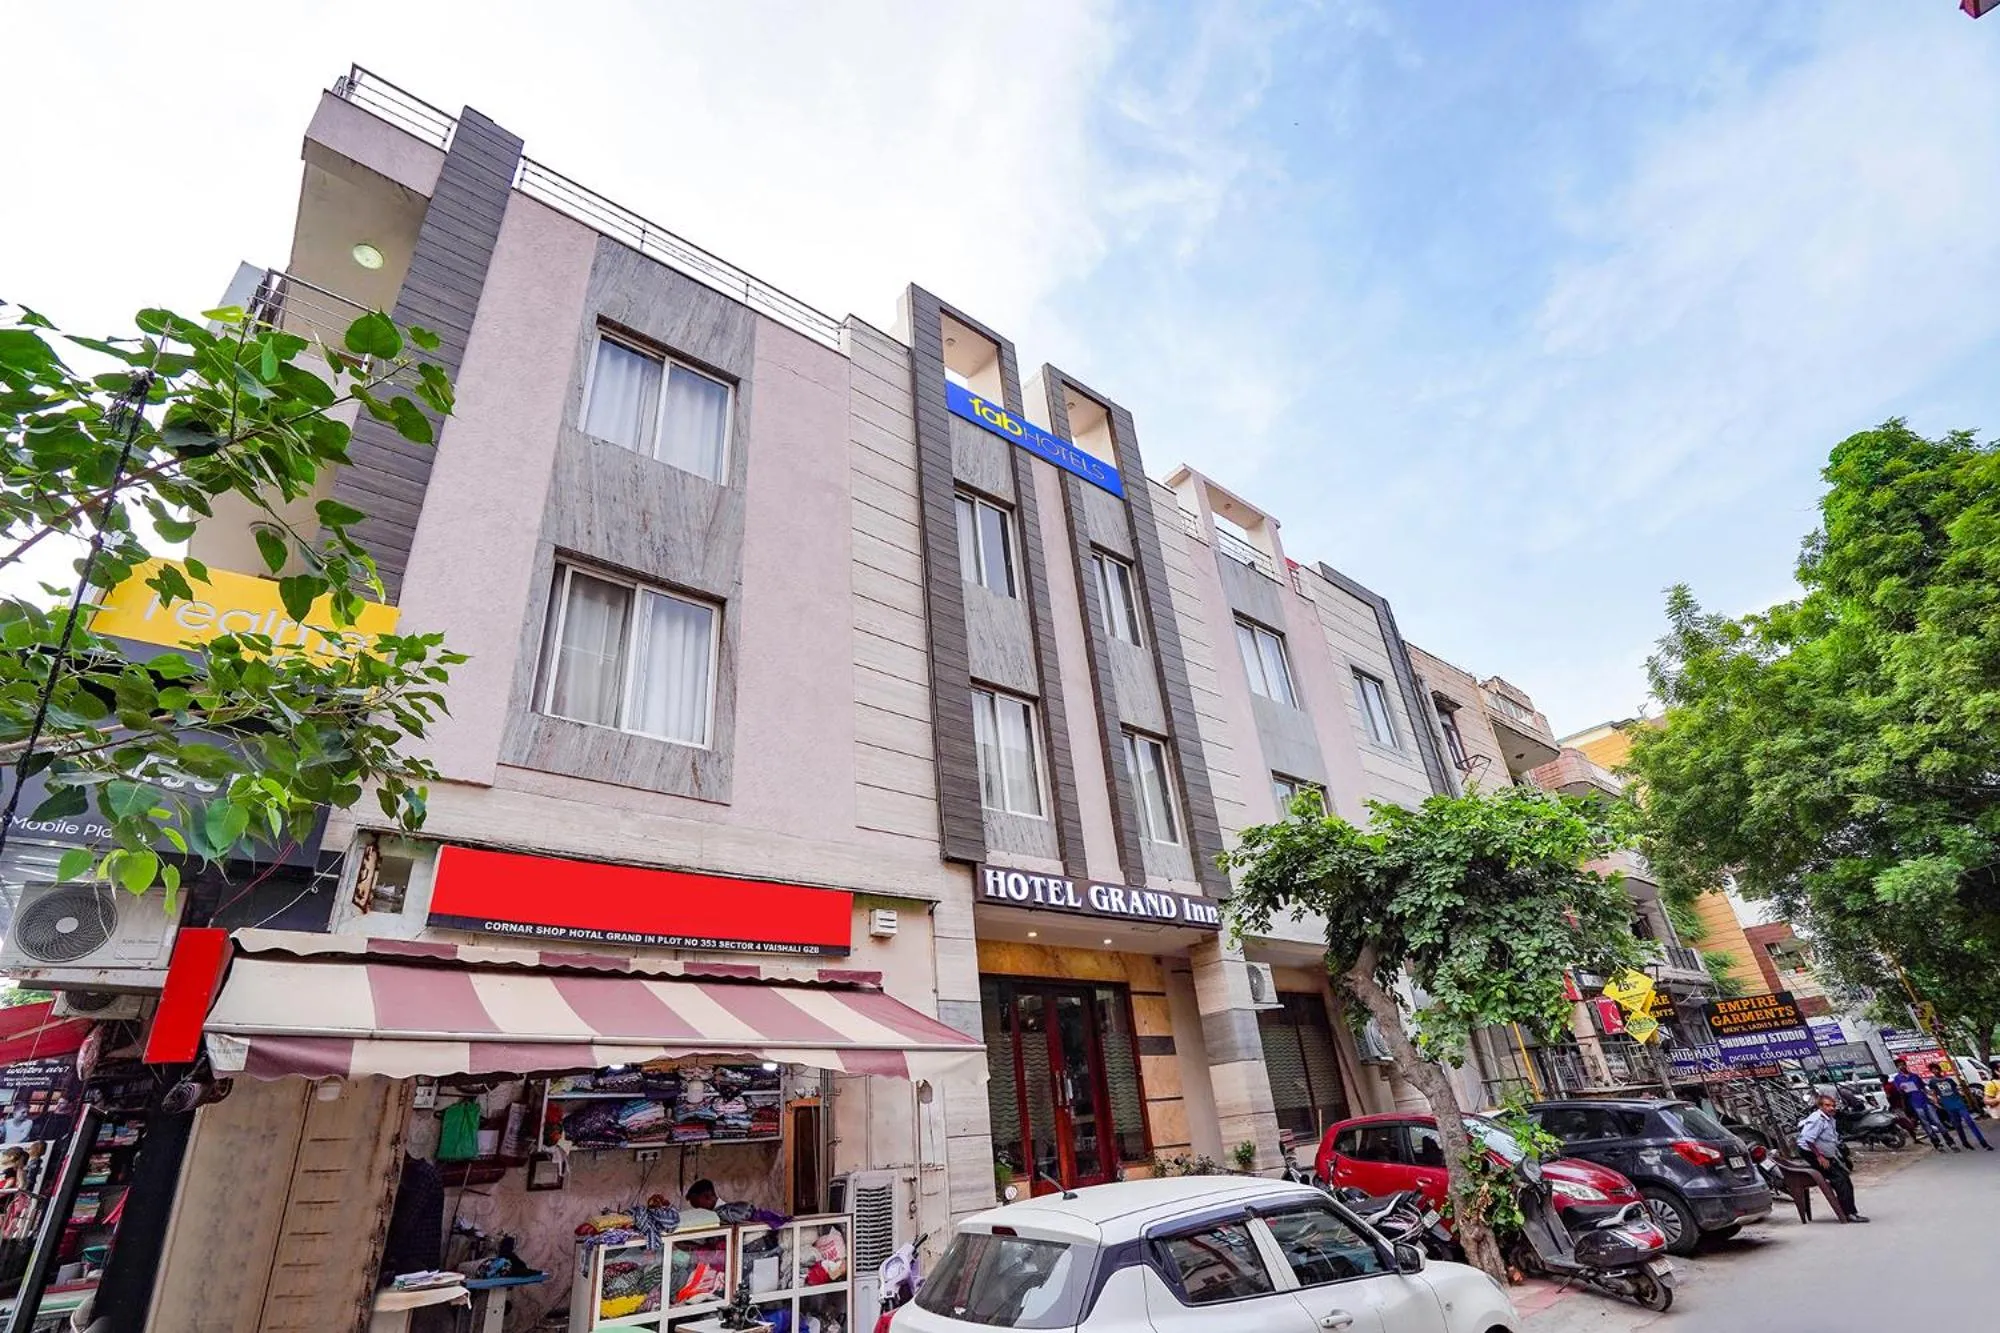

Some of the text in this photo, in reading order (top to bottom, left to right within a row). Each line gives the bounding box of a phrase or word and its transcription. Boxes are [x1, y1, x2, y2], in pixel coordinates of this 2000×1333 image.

[984, 868, 1221, 924] HOTEL GRAND Inn
[484, 921, 533, 934] CORNAR
[536, 926, 567, 937] SHOP
[569, 929, 604, 940] HOTAL
[606, 932, 642, 943] GRAND
[644, 935, 655, 943] IN
[657, 936, 682, 945] PLOT
[684, 938, 698, 947] NO
[700, 939, 717, 948] 353
[719, 940, 753, 951] SECTOR
[755, 943, 761, 951] 4
[763, 943, 801, 953] VAISHALI
[1716, 994, 1779, 1014] EMPIRE
[1711, 1005, 1795, 1026] GARMENTS
[1719, 1033, 1769, 1049] SHUBHAM
[1768, 1029, 1807, 1043] STUDIO
[1729, 1053, 1760, 1063] DIGITAL
[1760, 1049, 1794, 1060] COLOUR
